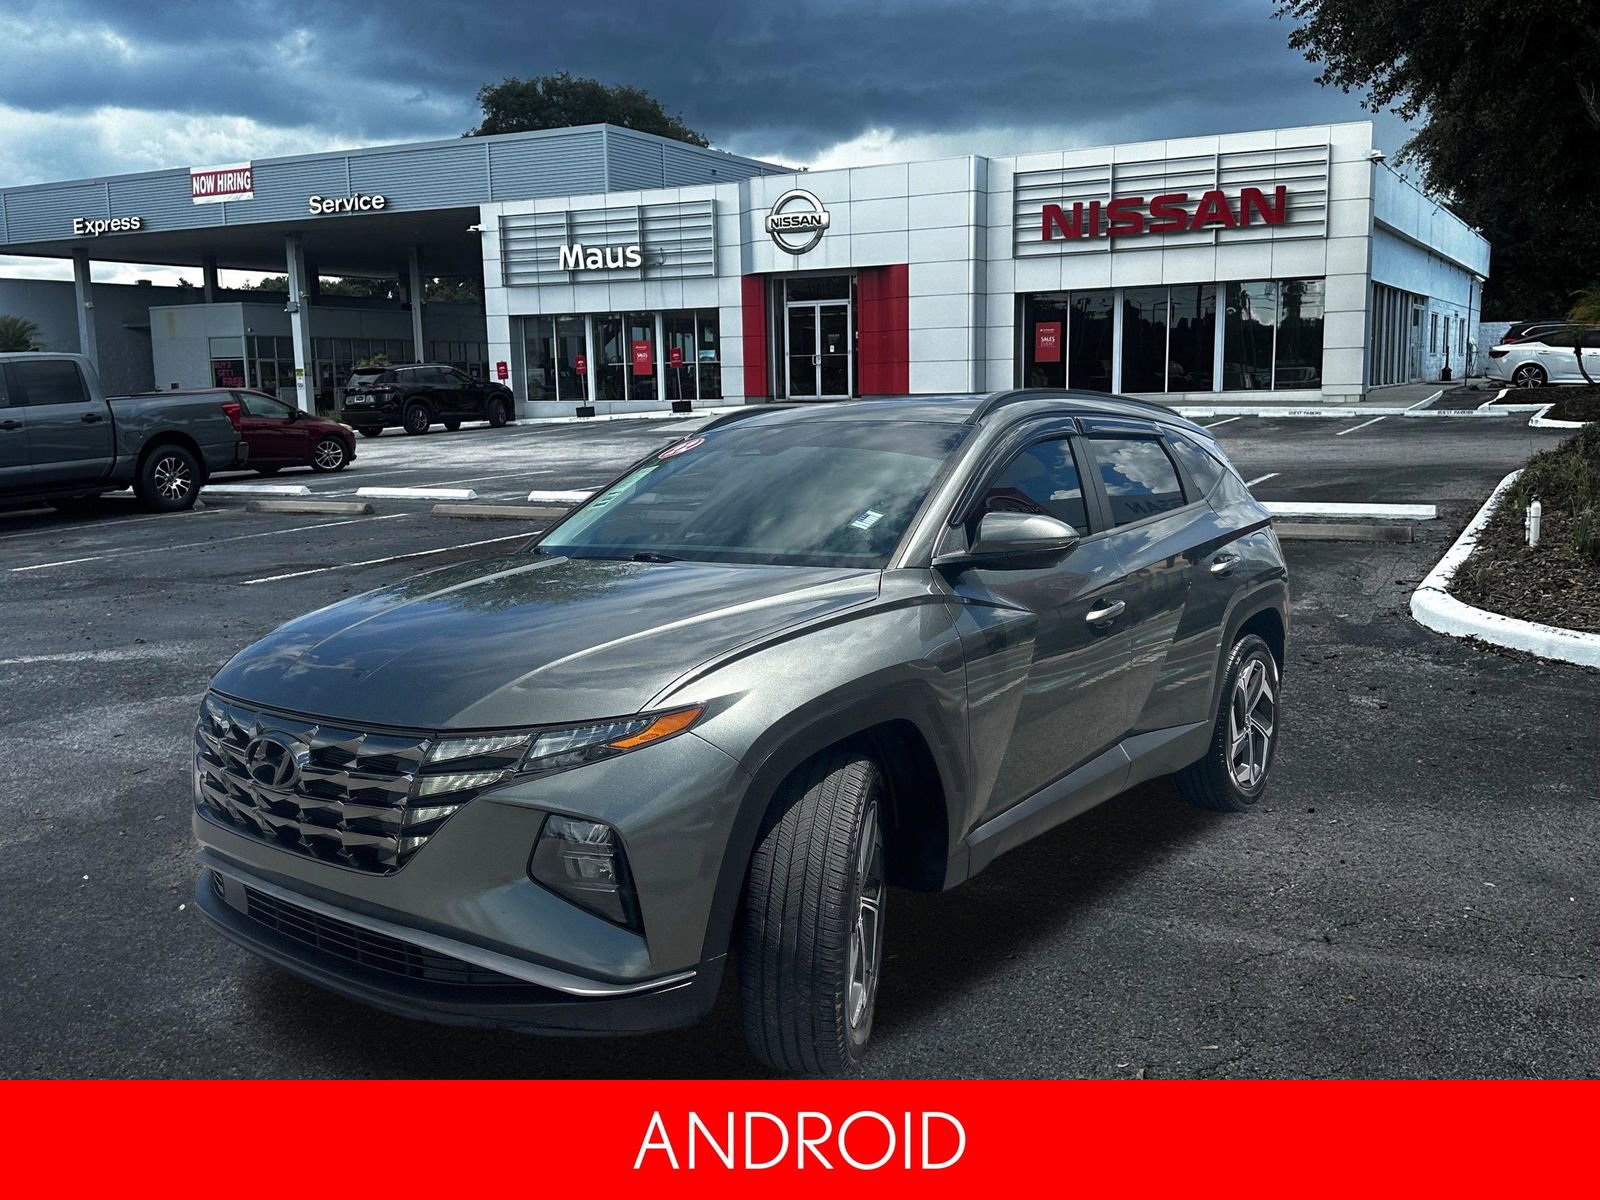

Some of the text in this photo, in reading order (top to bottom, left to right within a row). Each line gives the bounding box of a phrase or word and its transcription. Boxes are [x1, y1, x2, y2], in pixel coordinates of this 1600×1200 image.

[192, 171, 250, 194] NOW HIRING
[309, 193, 385, 215] Service
[1042, 185, 1286, 241] NISSAN
[73, 216, 141, 236] Express
[770, 214, 822, 228] NISSAN
[559, 243, 642, 271] Maus
[223, 377, 244, 387] FREE
